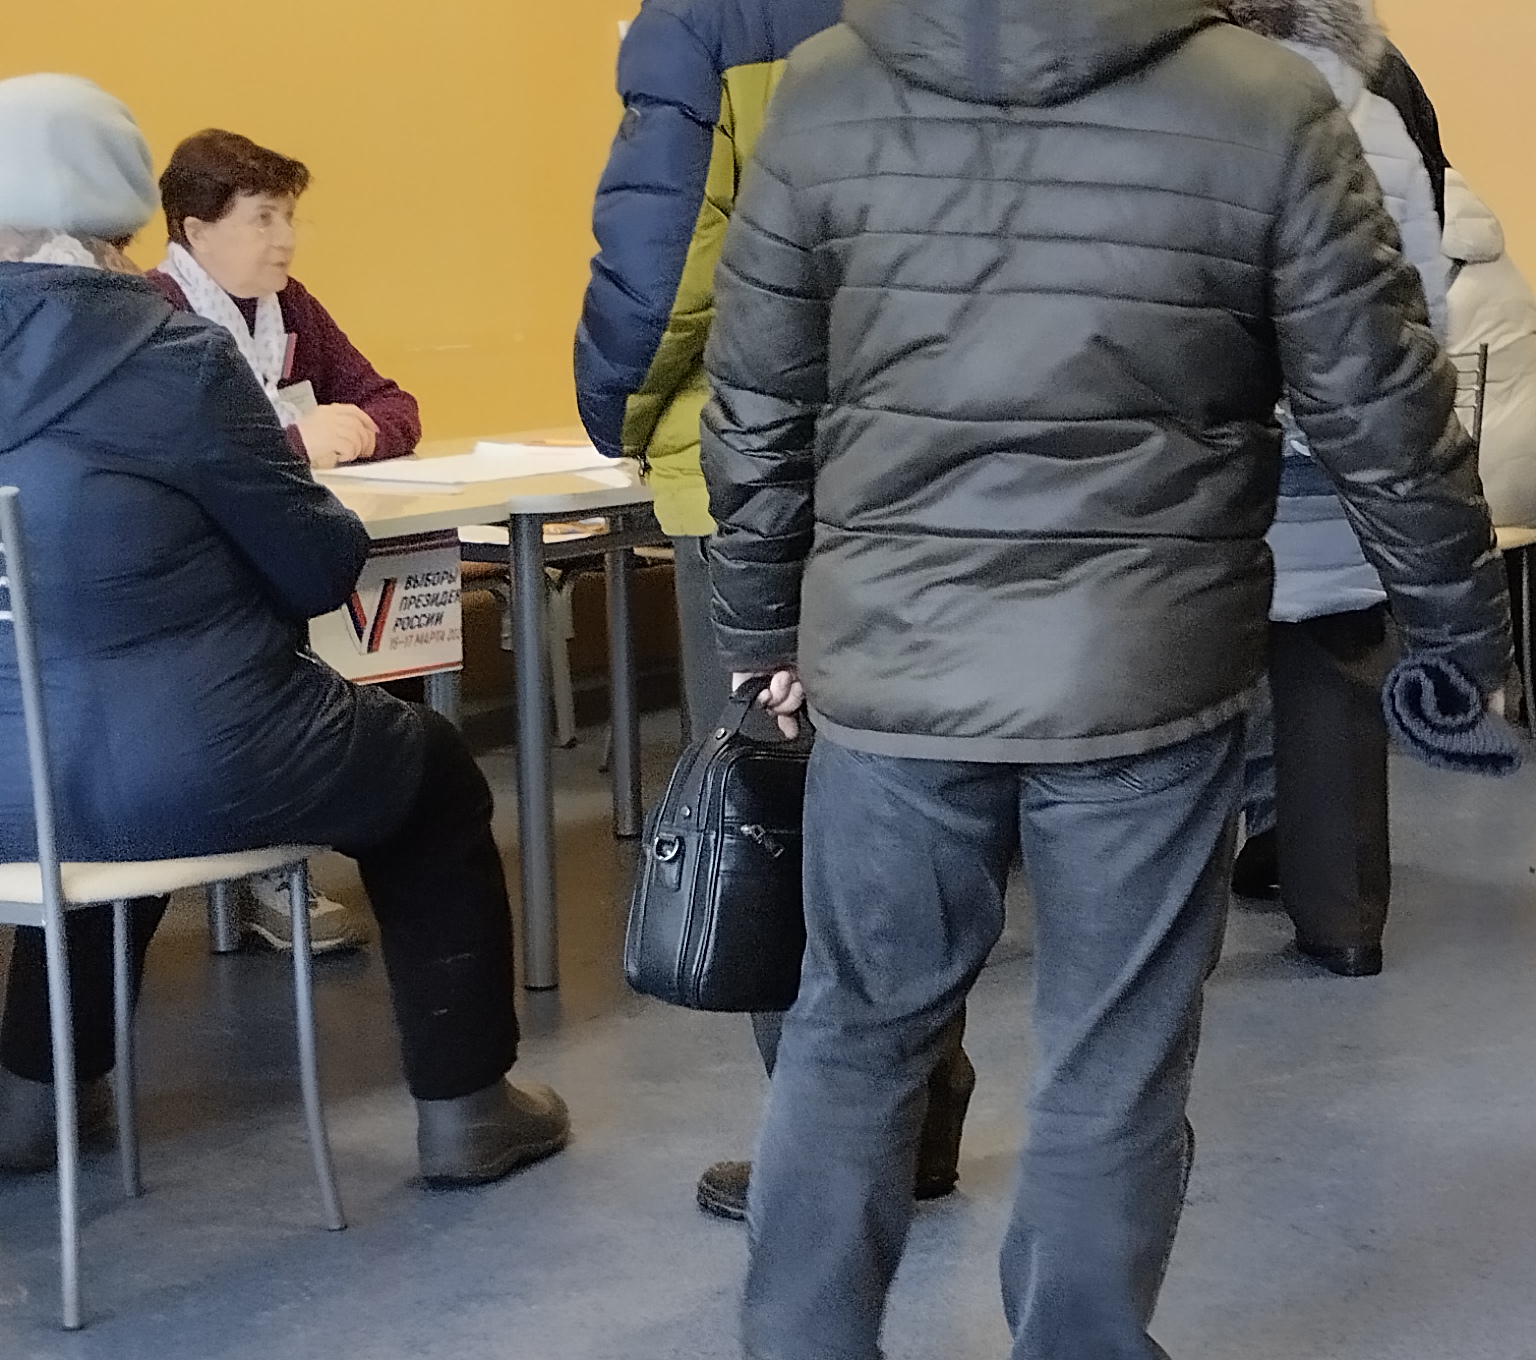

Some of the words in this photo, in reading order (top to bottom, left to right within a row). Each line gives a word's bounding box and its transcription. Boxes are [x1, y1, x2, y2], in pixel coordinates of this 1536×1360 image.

[404, 568, 458, 590] ВЫБОРЫ
[392, 611, 445, 633] РОССИИ
[414, 629, 446, 645] МАРТА
